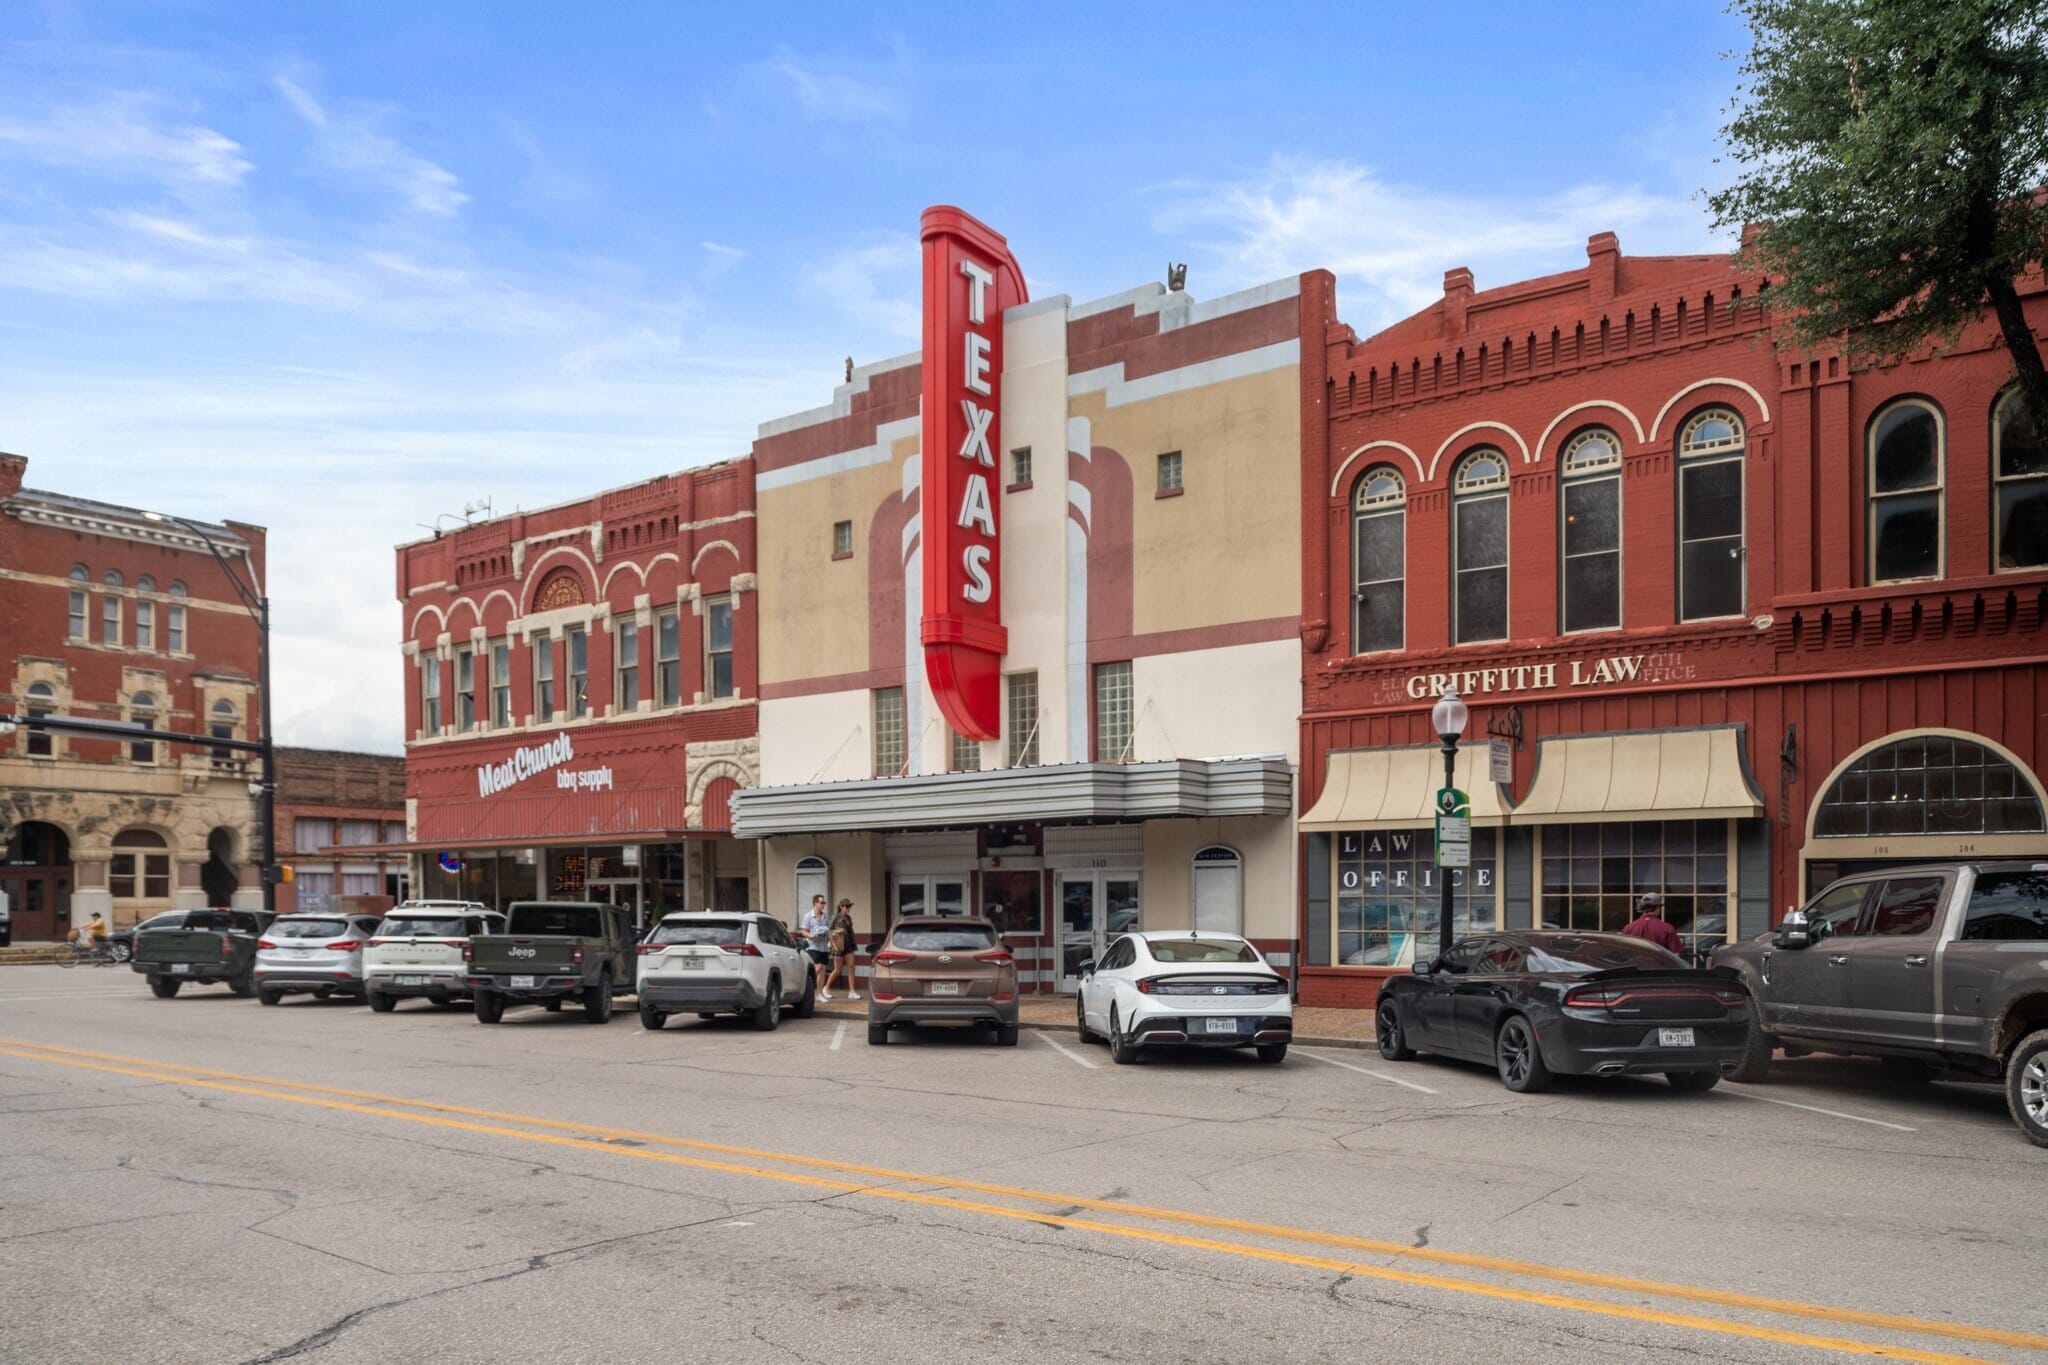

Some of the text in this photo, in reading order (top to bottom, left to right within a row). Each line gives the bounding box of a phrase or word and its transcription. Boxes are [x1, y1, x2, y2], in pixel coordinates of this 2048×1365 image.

[958, 258, 997, 604] TEXAS
[1406, 663, 1557, 699] GRIFFITH
[1570, 654, 1645, 686] LAW
[477, 732, 573, 798] Meat Church
[557, 765, 613, 793] bbq supply
[1344, 834, 1411, 853] LAW
[1874, 846, 1889, 854] 108
[1960, 844, 1975, 853] 106
[1092, 859, 1106, 869] 110
[1343, 868, 1491, 888] OFFICE
[508, 947, 536, 958] Jeep
